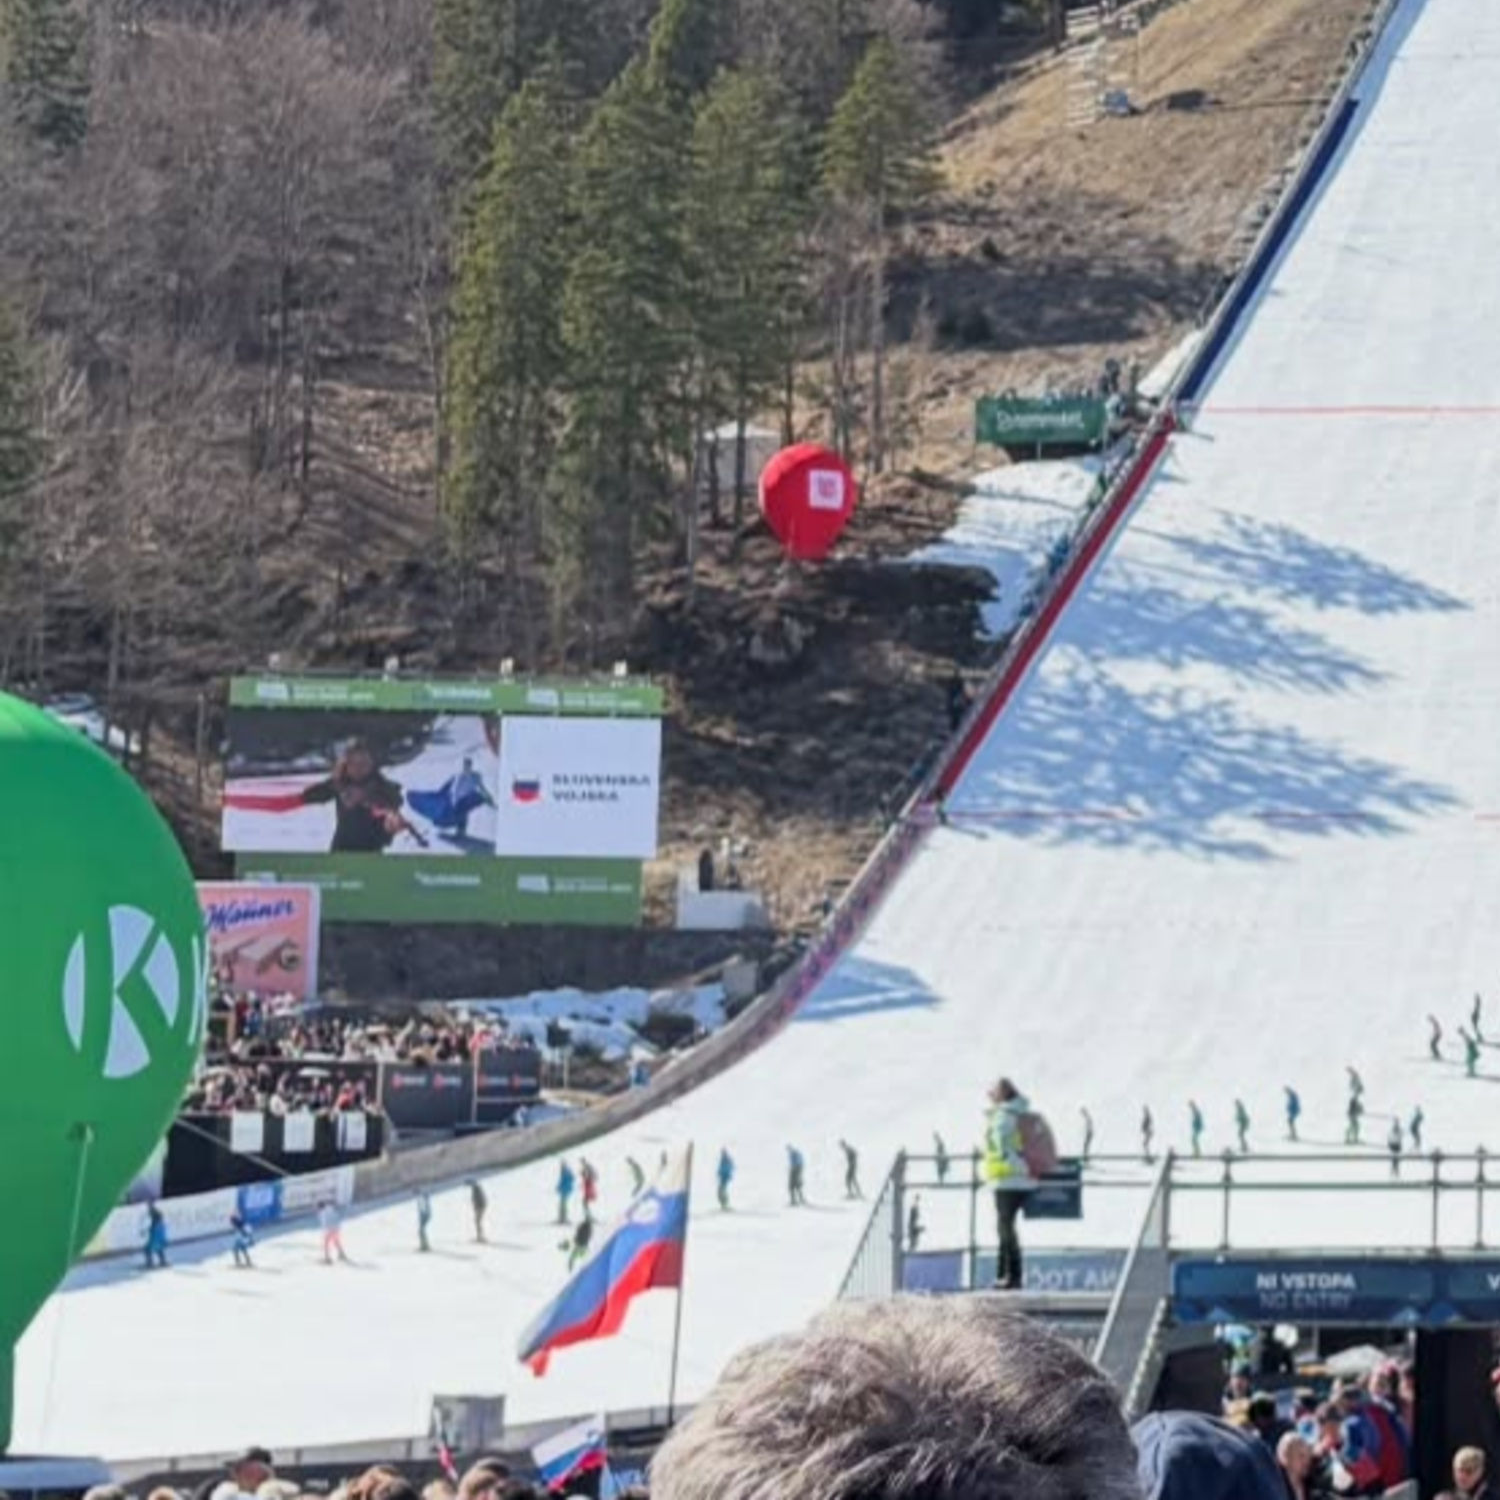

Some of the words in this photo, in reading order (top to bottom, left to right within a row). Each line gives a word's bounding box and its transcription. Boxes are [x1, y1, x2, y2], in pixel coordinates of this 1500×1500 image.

[1256, 1272, 1278, 1289] NI
[1280, 1272, 1356, 1290] VSTOPA
[1259, 1292, 1287, 1308] NO
[1291, 1291, 1351, 1309] ENTRY
